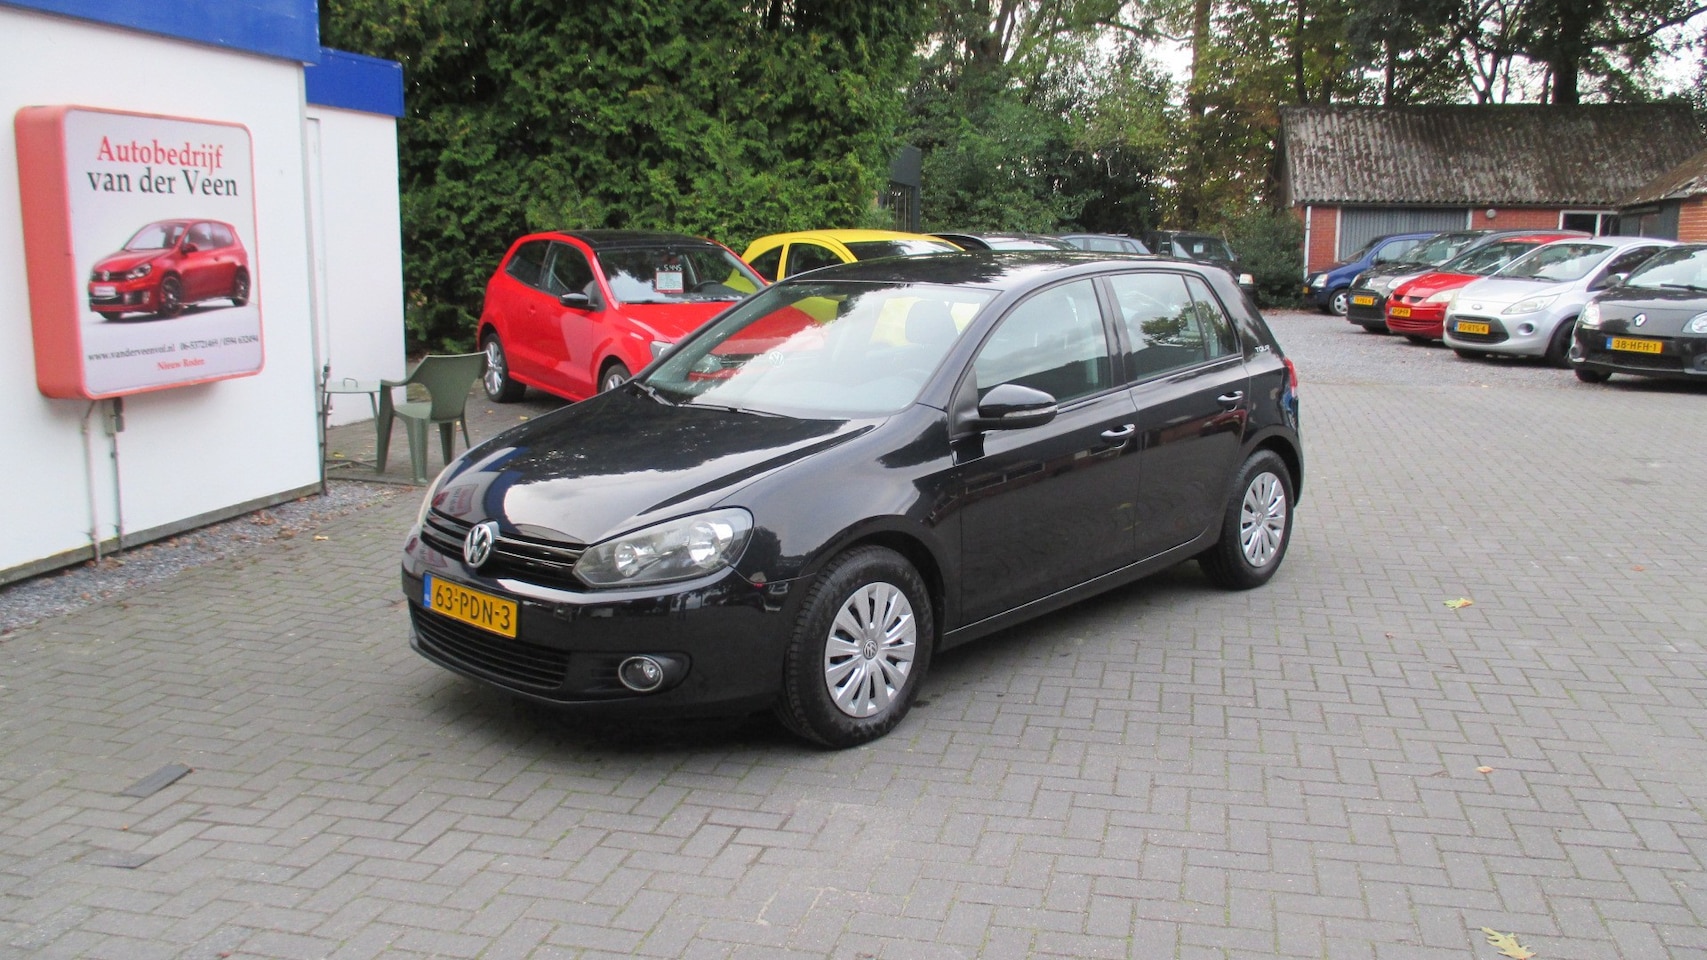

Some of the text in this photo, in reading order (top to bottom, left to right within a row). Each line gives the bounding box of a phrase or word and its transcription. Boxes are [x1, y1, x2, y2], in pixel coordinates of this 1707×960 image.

[97, 135, 224, 175] Autobedrijf
[87, 166, 239, 197] van der Veen
[1613, 339, 1658, 352] 38-HFH-1
[435, 584, 511, 630] 63-PDN-3
